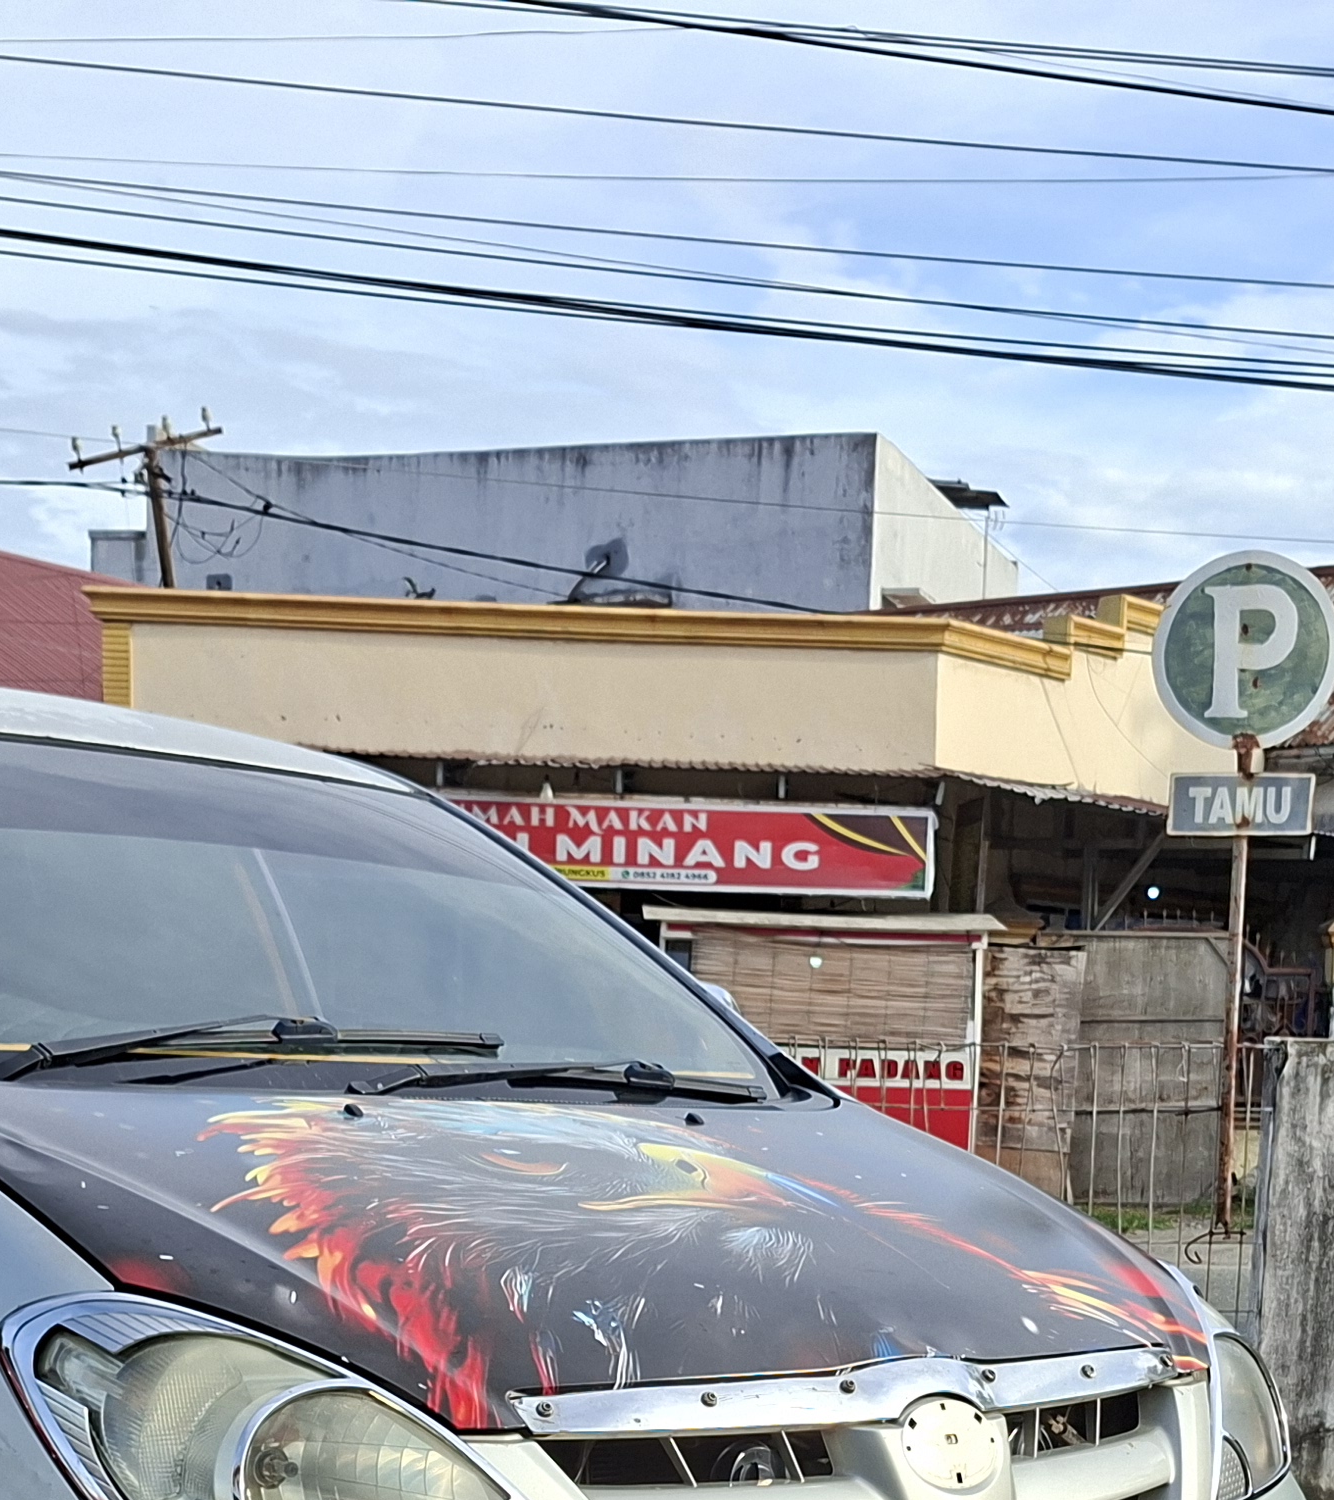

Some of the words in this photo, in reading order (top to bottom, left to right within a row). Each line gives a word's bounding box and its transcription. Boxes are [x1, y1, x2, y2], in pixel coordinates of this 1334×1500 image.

[1204, 584, 1298, 718] P
[459, 803, 554, 828] MAH
[565, 806, 708, 834] MAKAN
[1188, 786, 1291, 824] TAMU
[555, 834, 820, 871] MINANG
[838, 1057, 965, 1081] PADANG
